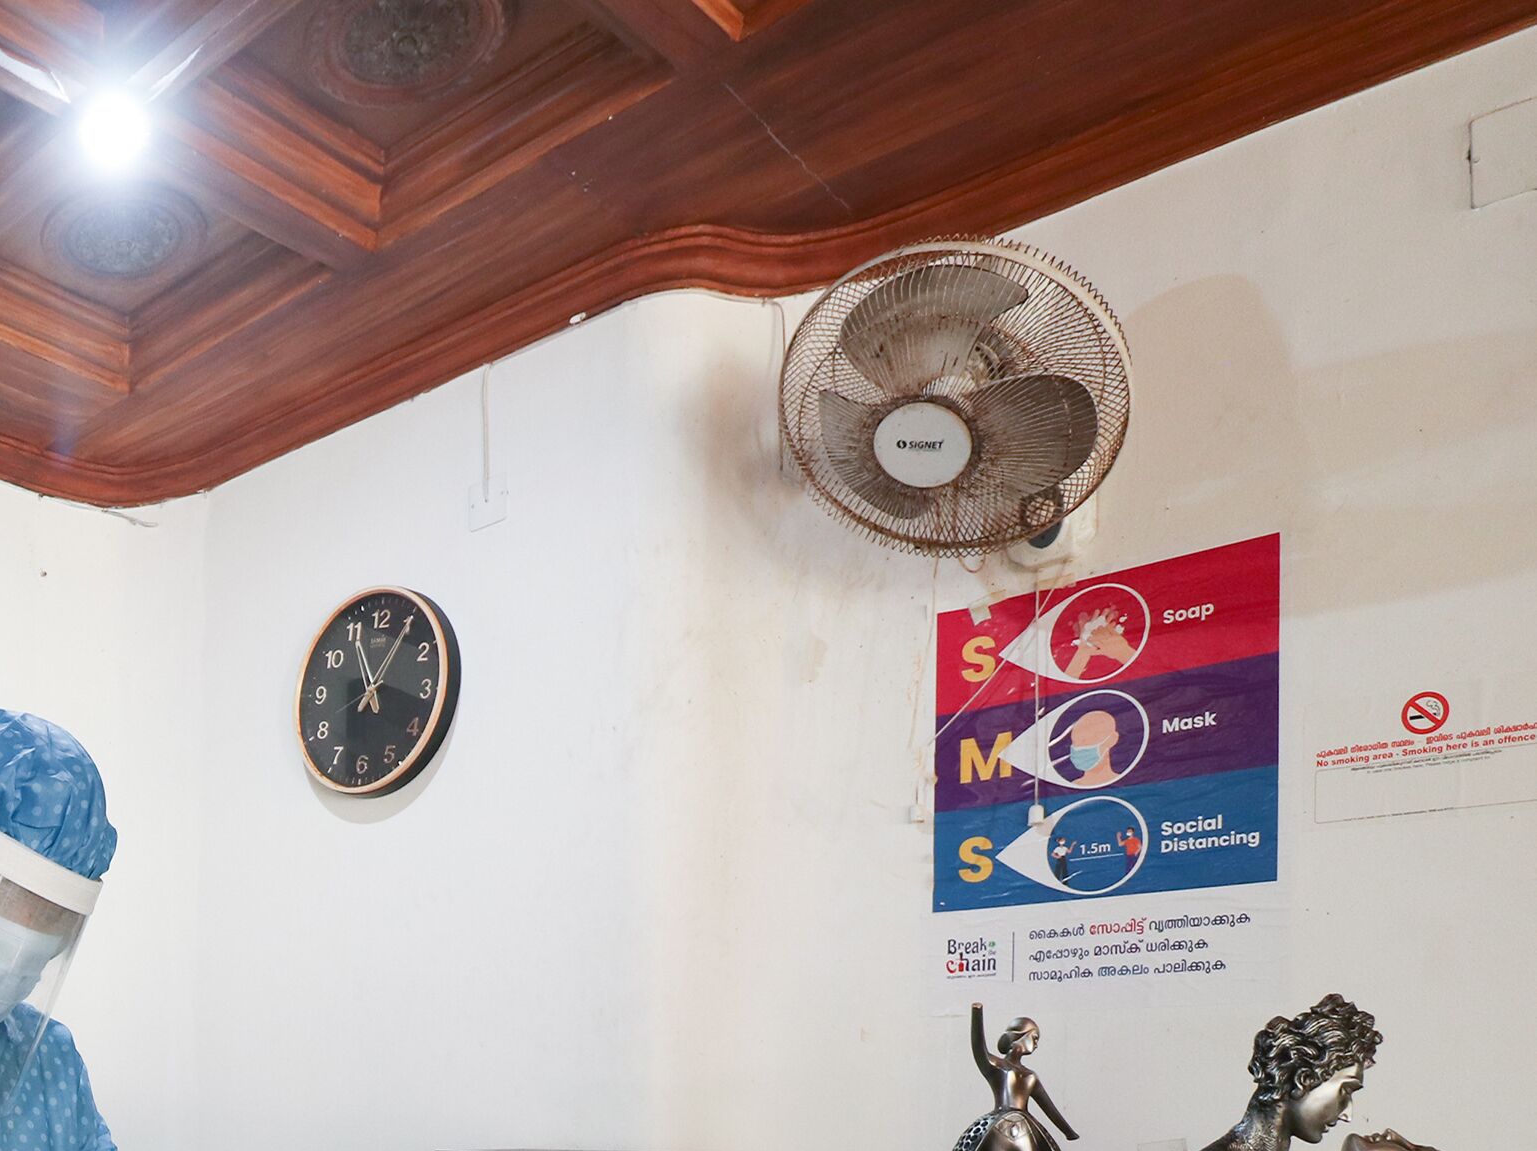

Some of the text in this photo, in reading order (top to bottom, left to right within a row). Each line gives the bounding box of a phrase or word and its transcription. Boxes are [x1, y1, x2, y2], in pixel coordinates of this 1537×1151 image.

[908, 439, 944, 450] SIGNET
[371, 609, 391, 629] 12
[1163, 602, 1215, 624] Soap
[347, 622, 362, 641] 11
[325, 650, 344, 669] 10
[416, 642, 430, 662] 2
[962, 635, 996, 683] S
[315, 686, 327, 704] 9
[419, 679, 432, 699] 3
[317, 721, 329, 739] 8
[406, 717, 419, 737] 4
[1161, 711, 1217, 734] Mask
[333, 746, 344, 765] 7
[384, 745, 396, 764] 5
[959, 732, 1012, 784] M
[1331, 754, 1370, 763] smoking
[1372, 752, 1393, 760] area
[1402, 746, 1443, 757] Smoking
[1446, 742, 1468, 751] here
[1471, 739, 1480, 748] is
[1482, 738, 1495, 746] an
[1497, 733, 1536, 744] offence
[356, 755, 369, 775] 6
[1161, 814, 1223, 837] Social
[1079, 841, 1111, 855] 1.5m
[1160, 830, 1260, 854] Distancing
[958, 836, 995, 883] S
[948, 937, 987, 954] Break
[946, 952, 996, 974] chain
[1098, 964, 1150, 977] അകലം
